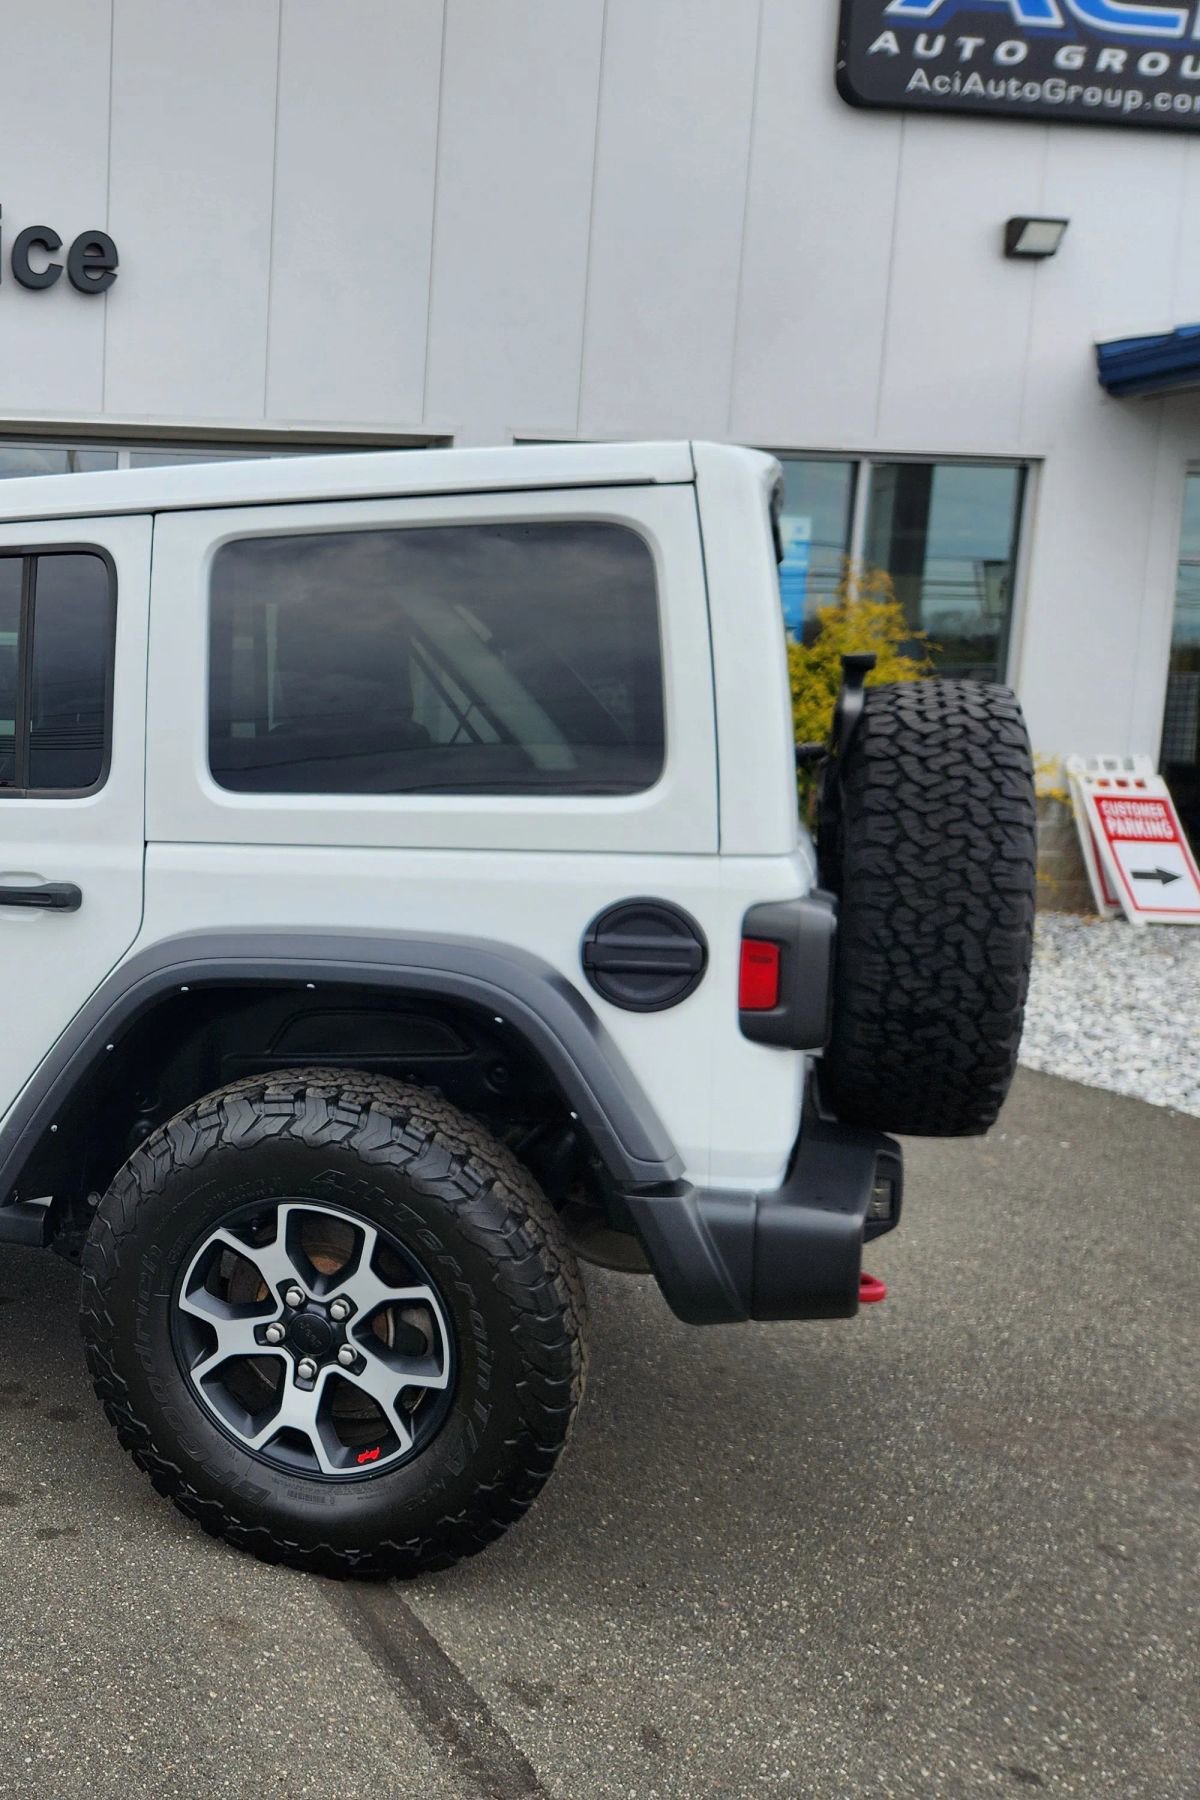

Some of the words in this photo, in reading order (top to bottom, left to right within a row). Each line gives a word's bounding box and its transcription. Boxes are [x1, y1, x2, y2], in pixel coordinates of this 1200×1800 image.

[867, 30, 1028, 66] AUTO
[905, 67, 1200, 113] AciAutoGroup.co
[1101, 800, 1166, 817] CUSTOMER
[1106, 816, 1174, 840] PARKING
